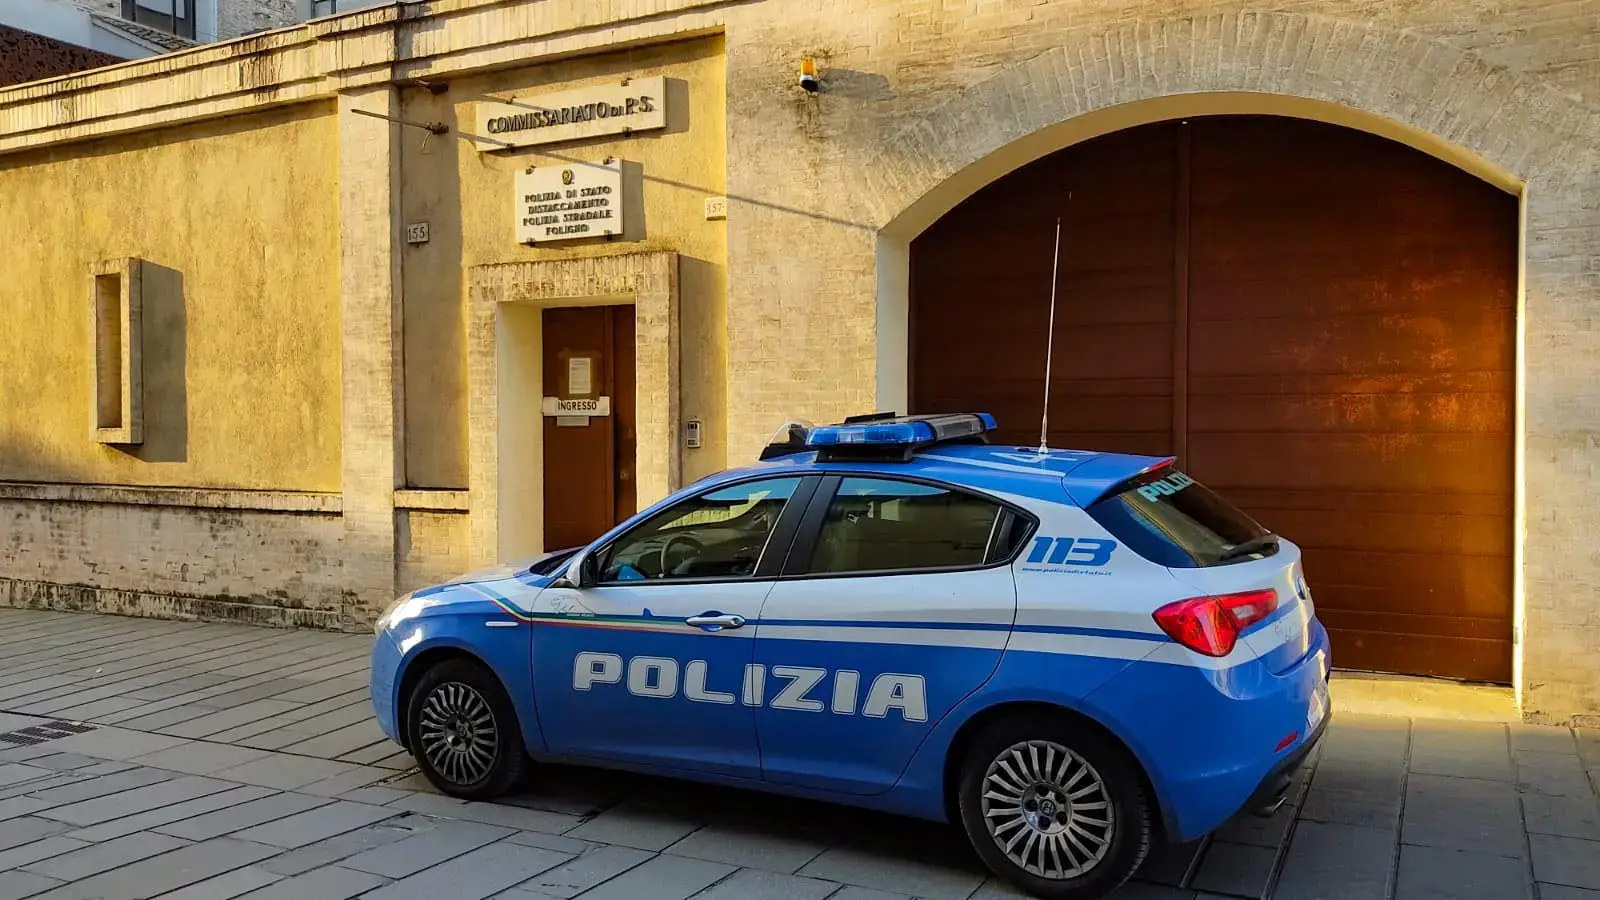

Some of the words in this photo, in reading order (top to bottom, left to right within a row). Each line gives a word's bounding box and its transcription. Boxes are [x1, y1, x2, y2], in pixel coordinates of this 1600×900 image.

[487, 102, 609, 134] COMMISSARIATO
[525, 191, 561, 203] POLIZIA
[566, 189, 577, 199] DI
[580, 186, 612, 197] STATO
[528, 198, 609, 214] DISTACCAMENTO
[523, 215, 560, 226] POLIZIA
[563, 209, 613, 222] STRADALE
[408, 226, 426, 240] 155
[546, 223, 590, 235] FOLIGNO
[557, 400, 597, 411] INGRESSO
[1026, 536, 1117, 566] 113
[572, 651, 928, 723] POLIZIA
